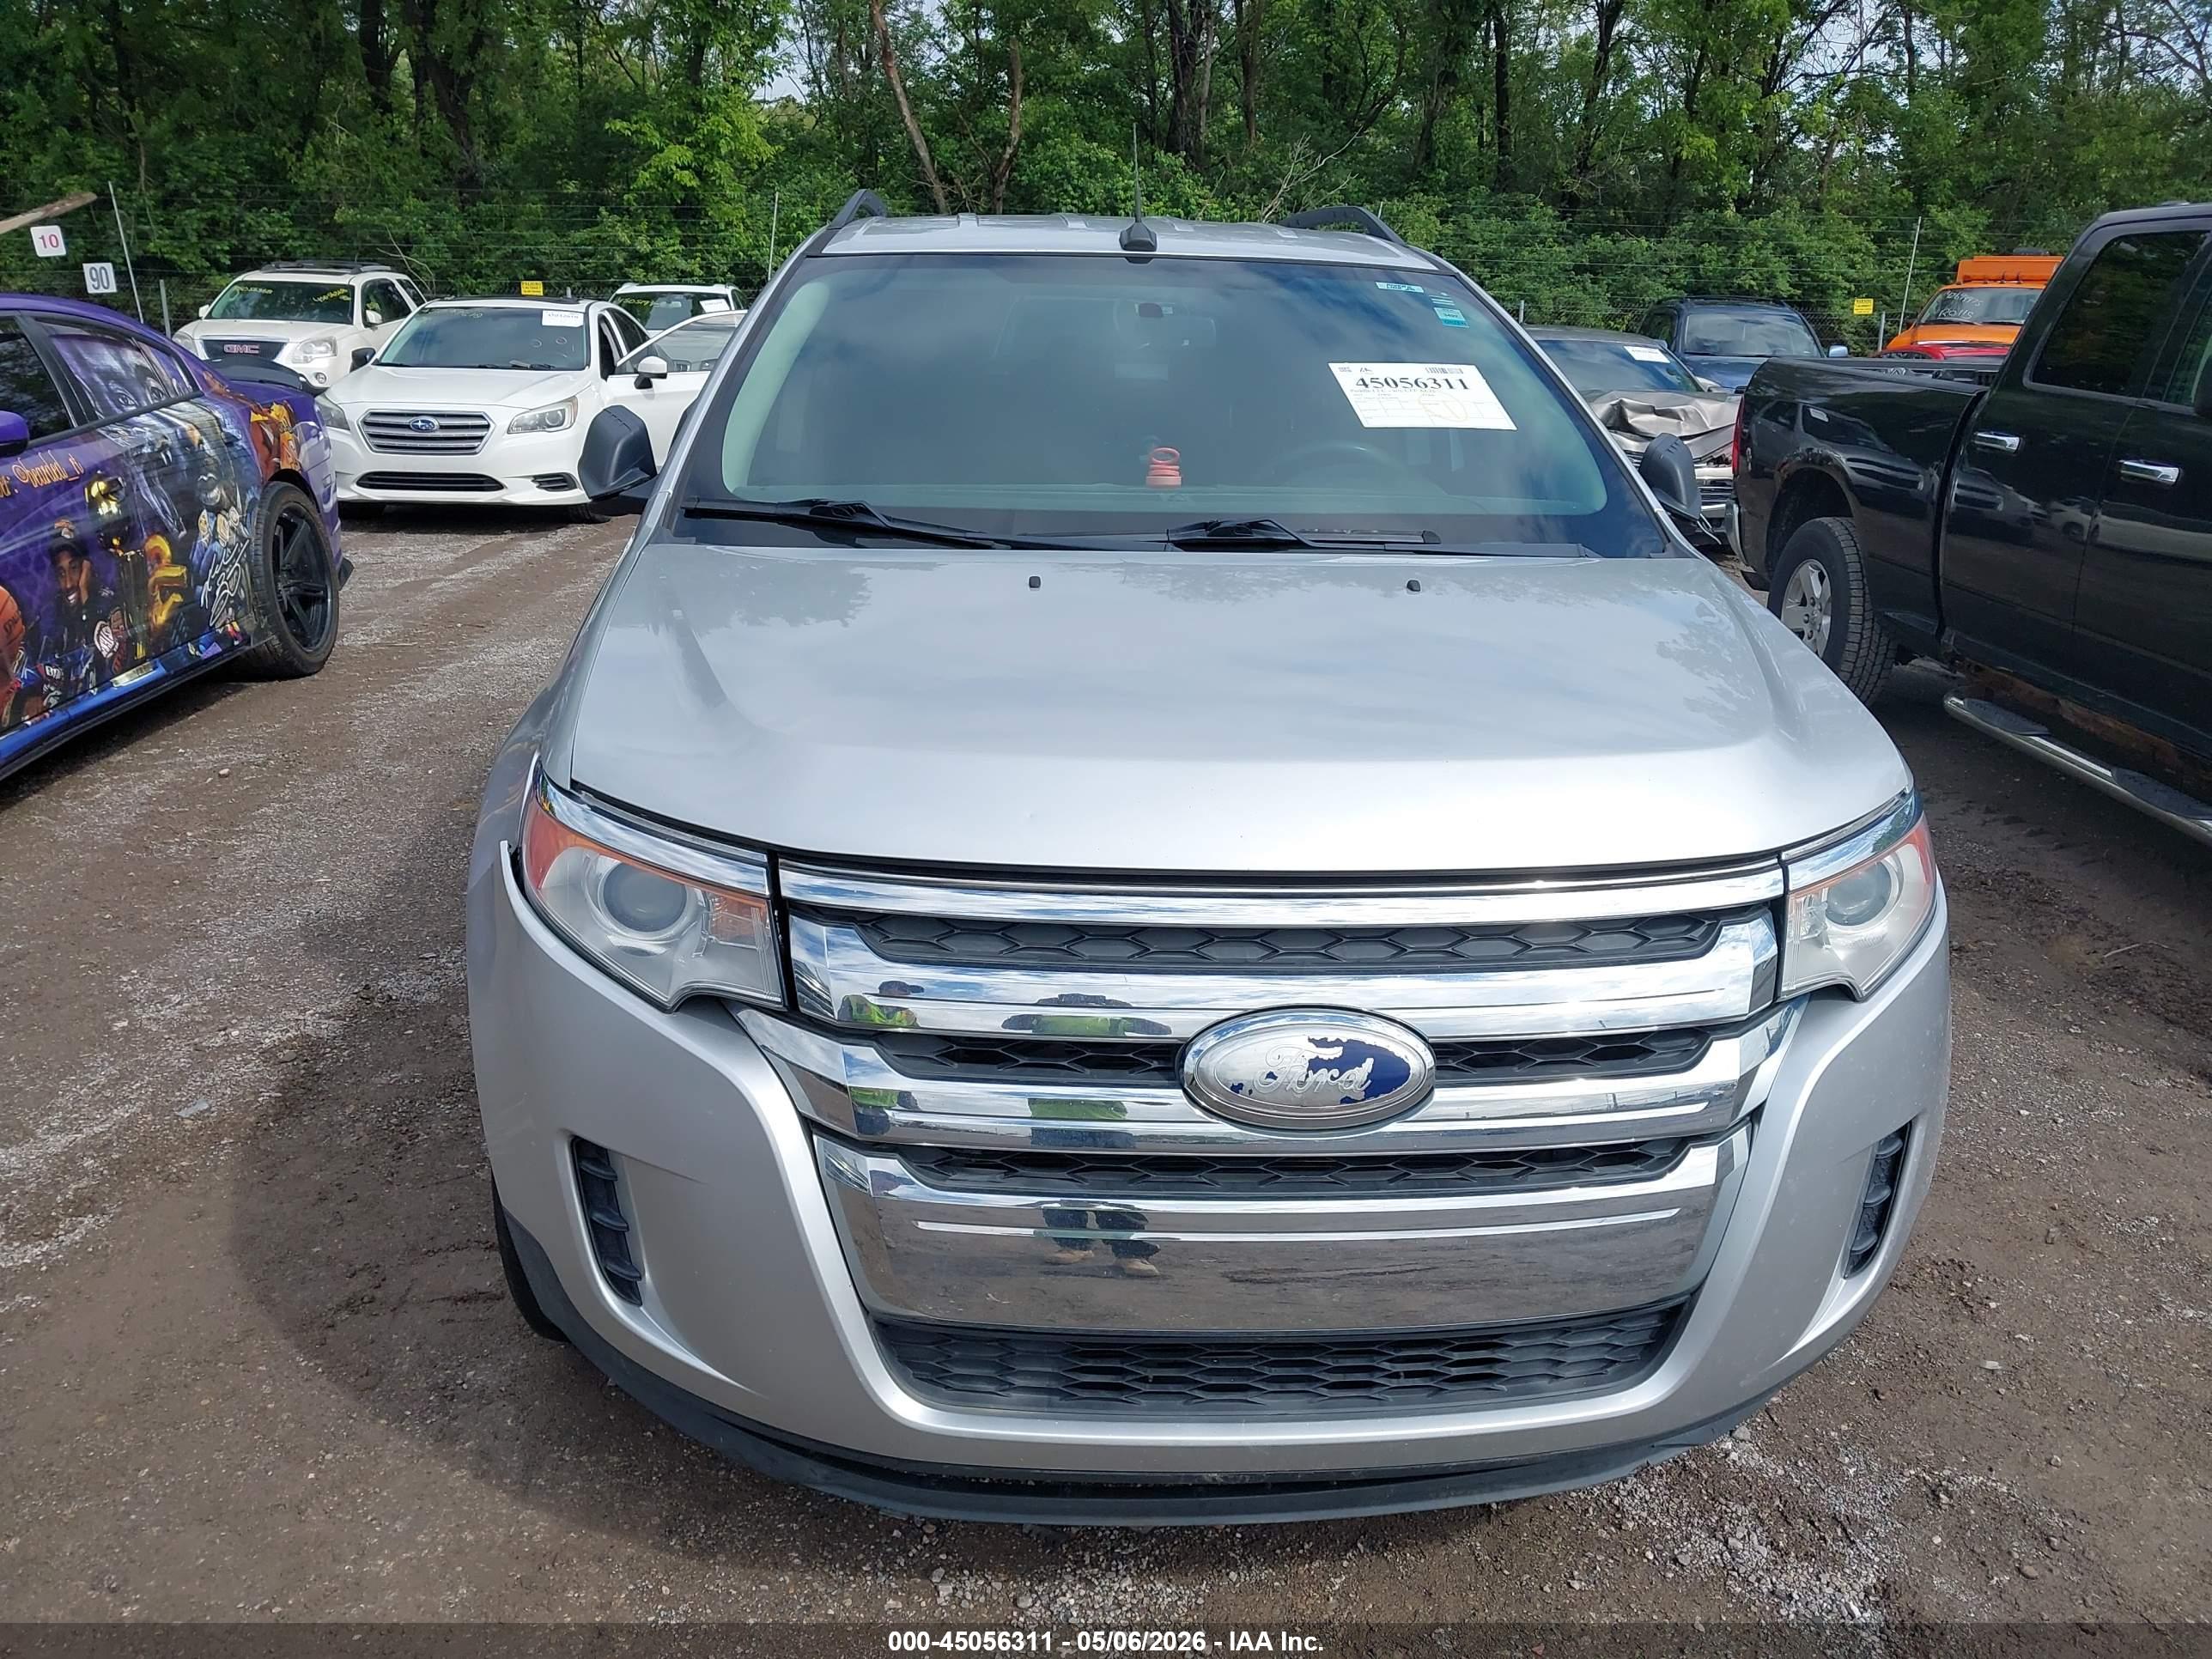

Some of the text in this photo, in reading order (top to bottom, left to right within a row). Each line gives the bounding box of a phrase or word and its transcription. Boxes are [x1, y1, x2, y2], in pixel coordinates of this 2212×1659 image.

[39, 234, 59, 249] 10
[88, 266, 110, 290] 90
[224, 344, 259, 354] GMC
[1355, 377, 1471, 390] 45056311
[1253, 1043, 1375, 1095] Ford
